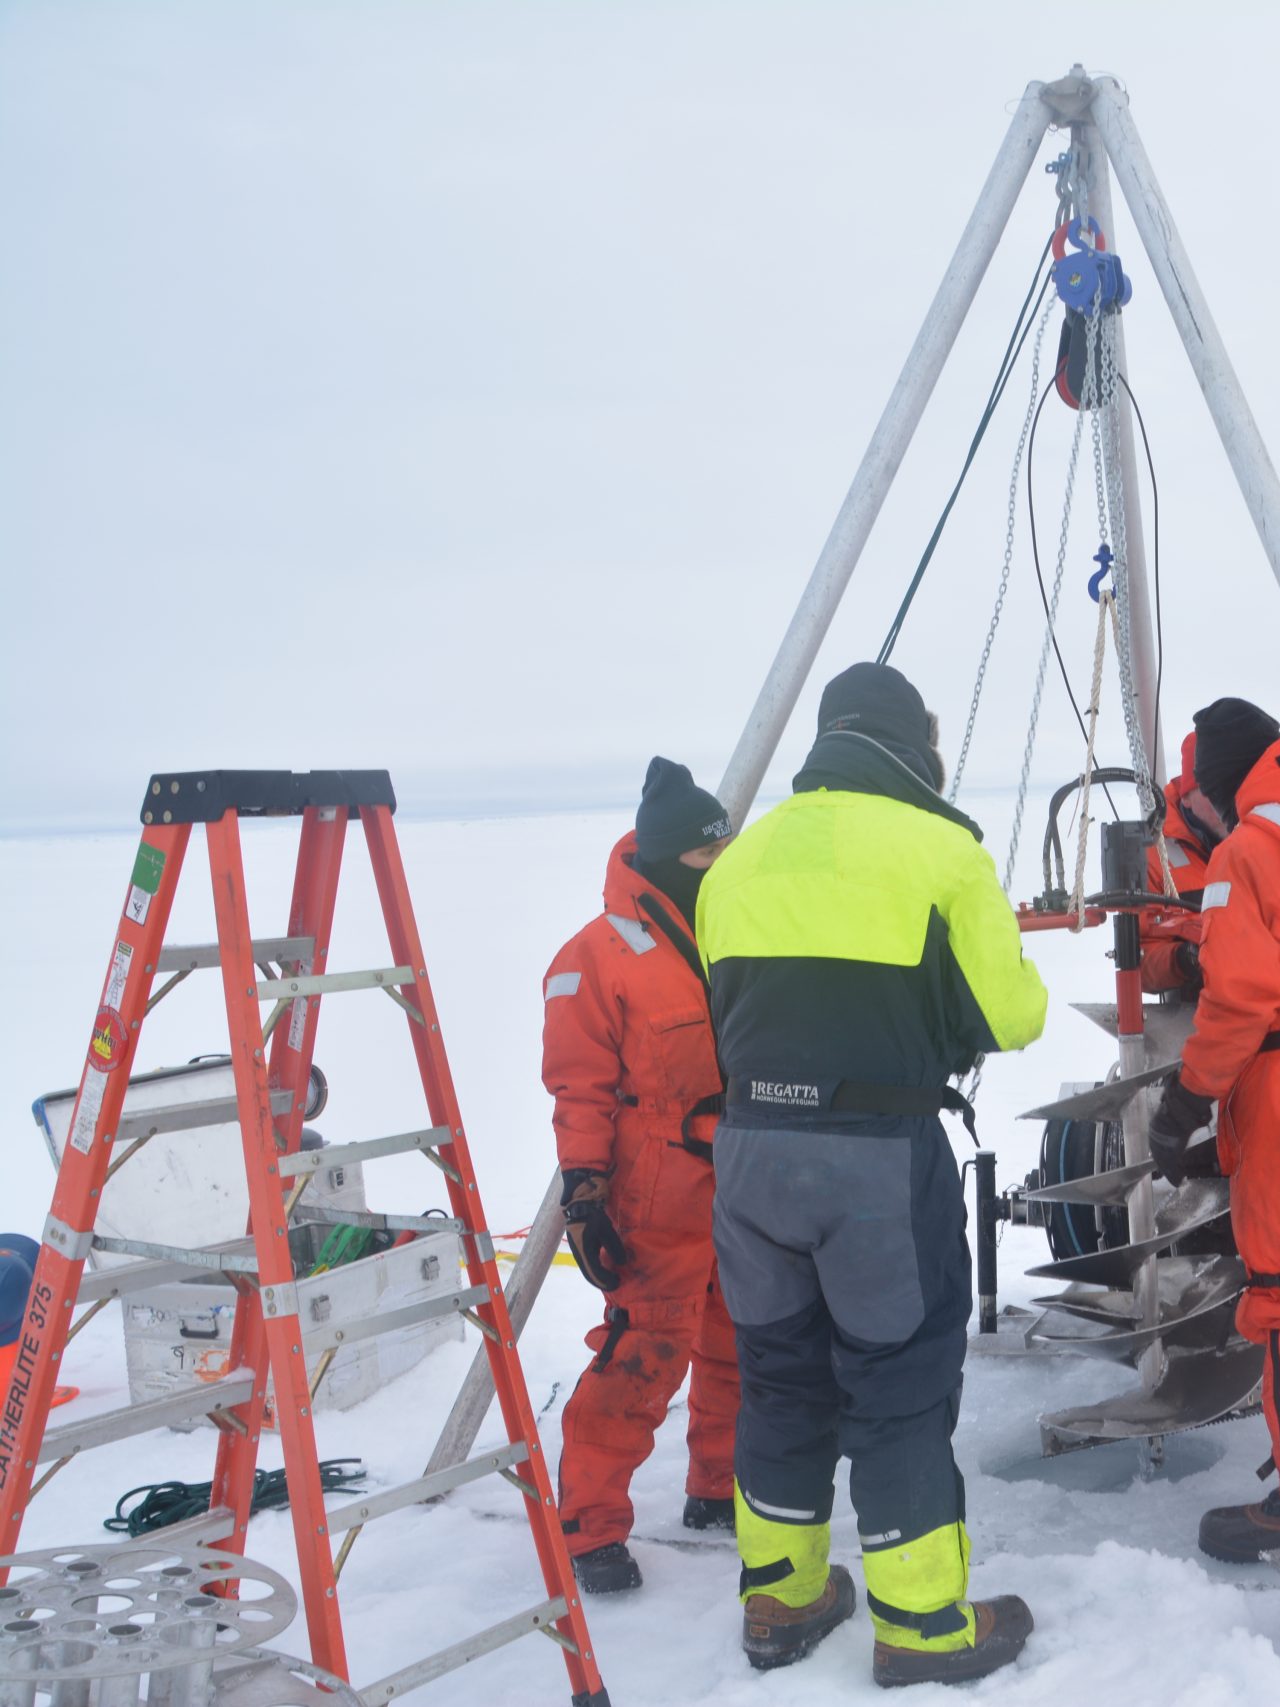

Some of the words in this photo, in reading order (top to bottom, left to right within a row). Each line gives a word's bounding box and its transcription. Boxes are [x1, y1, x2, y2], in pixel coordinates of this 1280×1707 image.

[757, 1081, 819, 1099] REGATTA
[757, 1095, 787, 1104] NORWEGIAN
[788, 1098, 819, 1106] LIFEGUARD
[29, 1283, 52, 1329] 375
